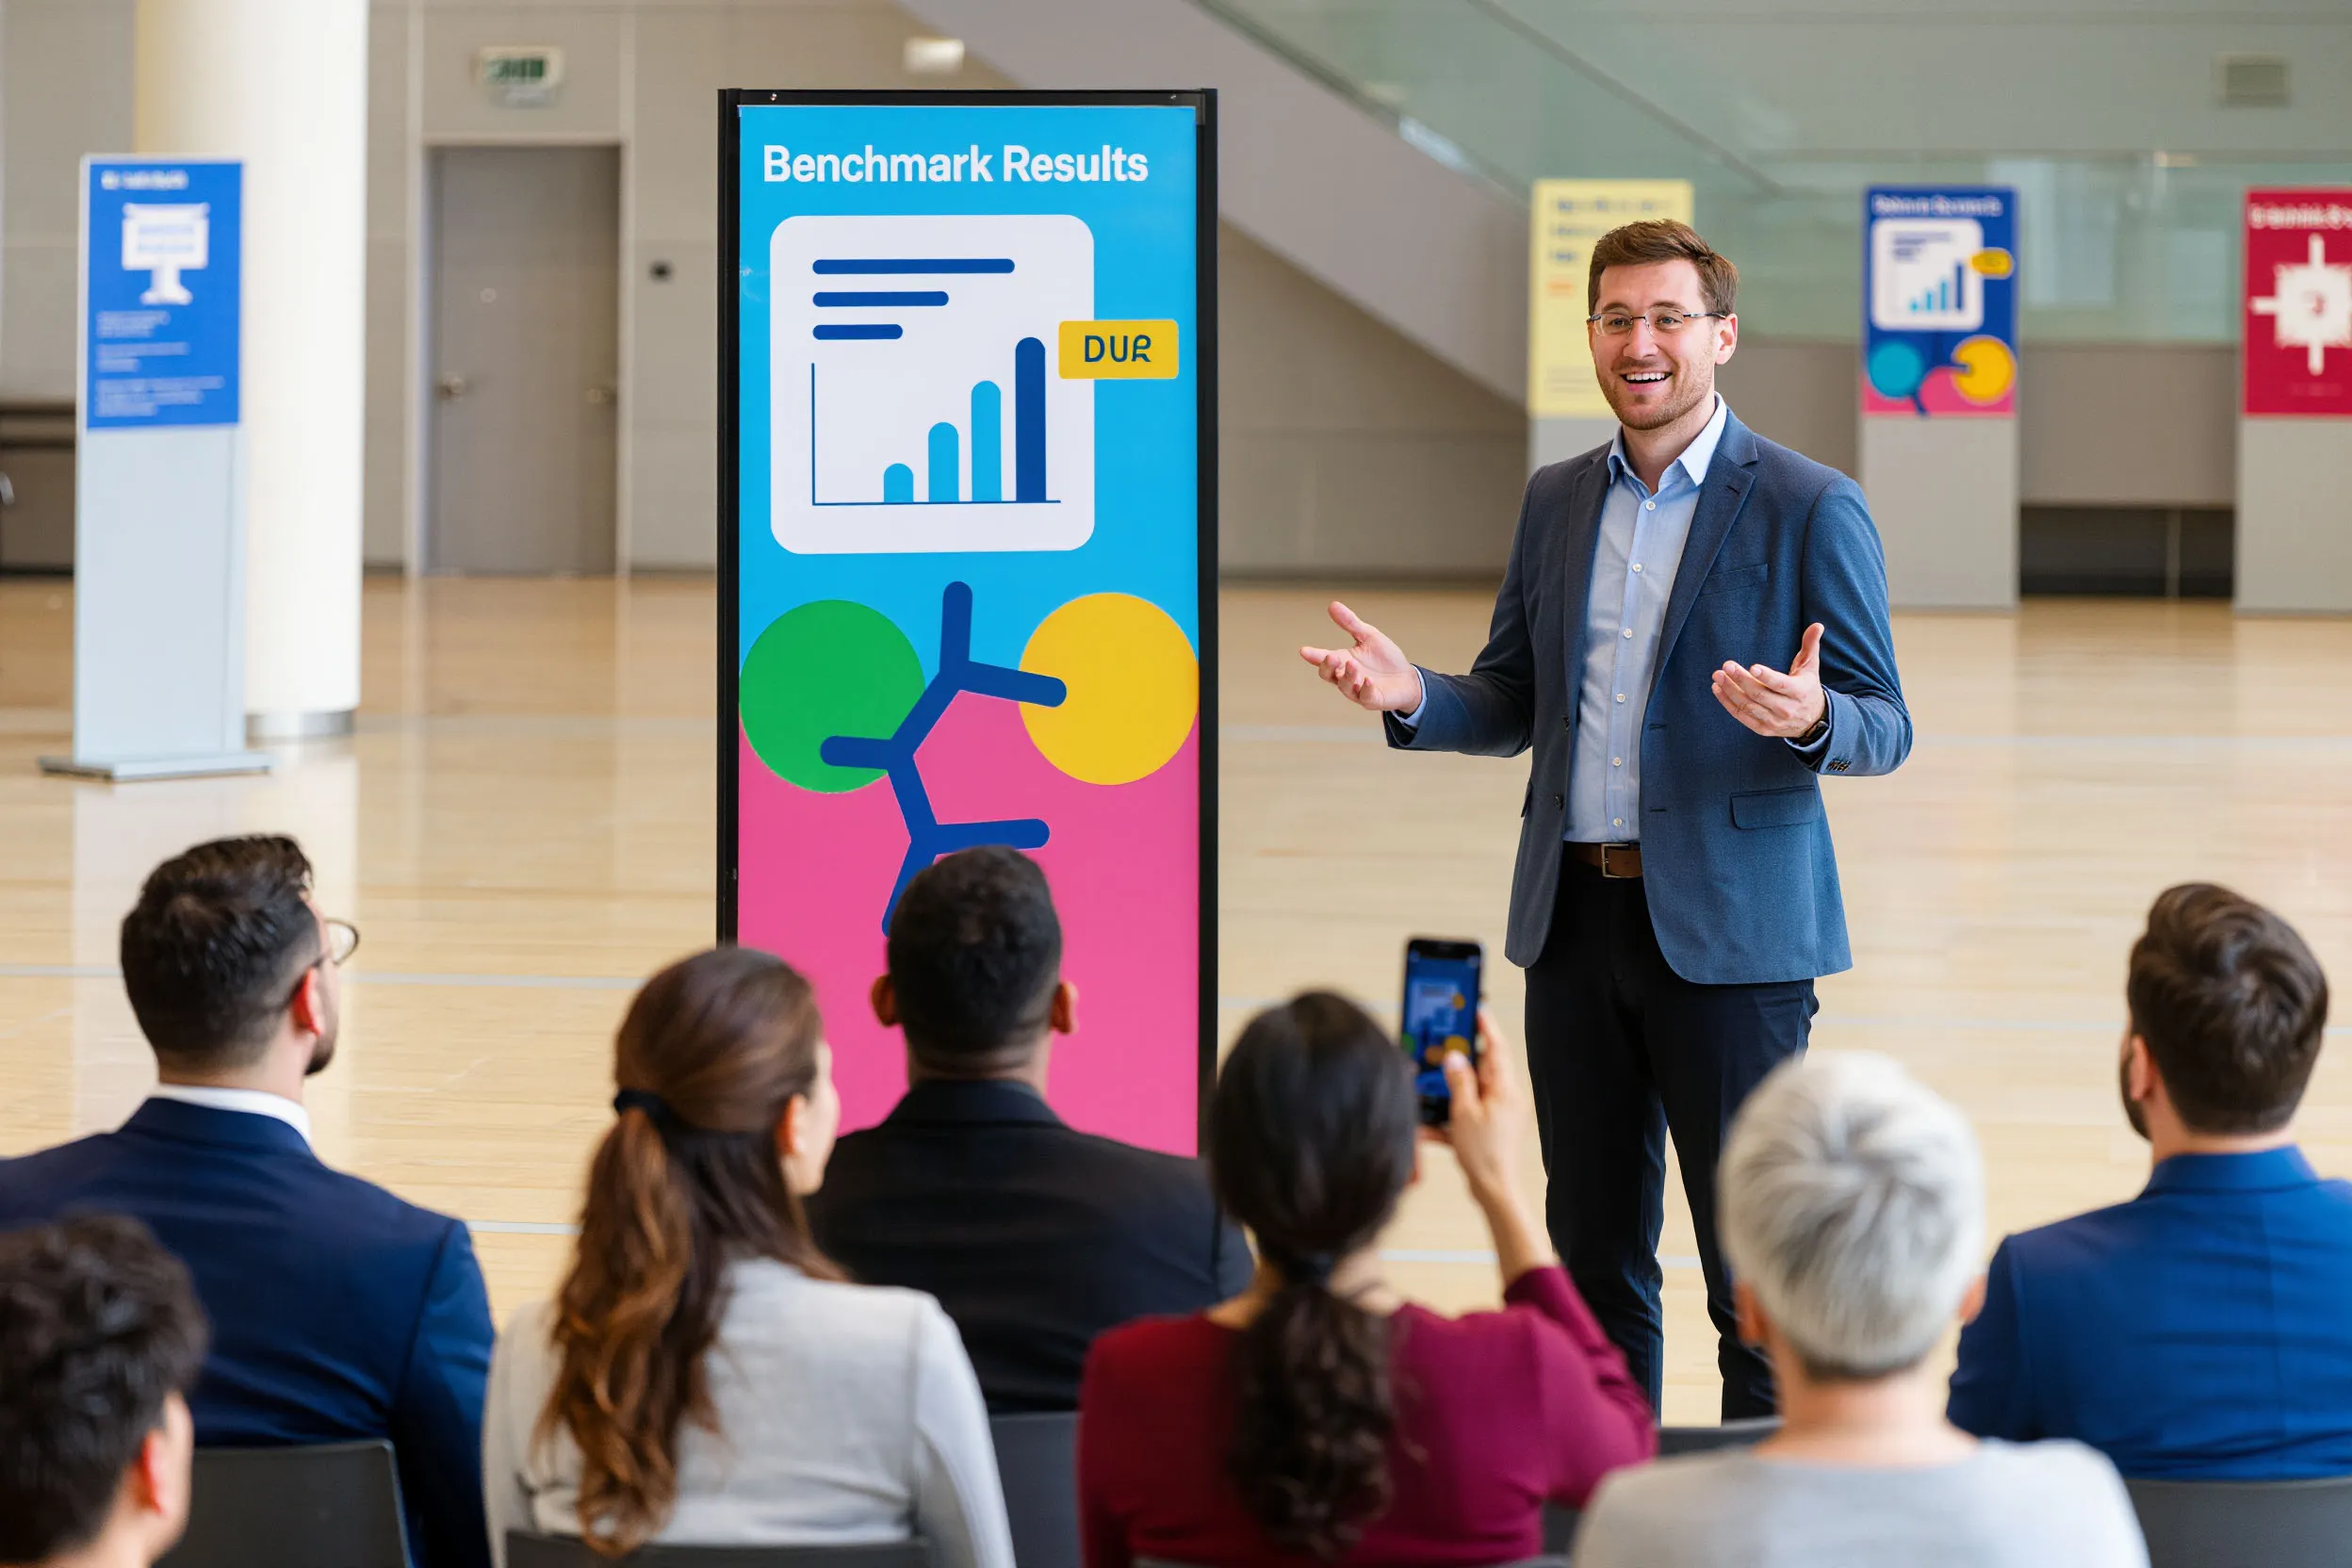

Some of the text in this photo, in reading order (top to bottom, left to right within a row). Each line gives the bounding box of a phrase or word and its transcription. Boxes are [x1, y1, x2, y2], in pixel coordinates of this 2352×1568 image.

[763, 144, 1149, 182] Benchmark Results
[1084, 334, 1152, 363] DUR
